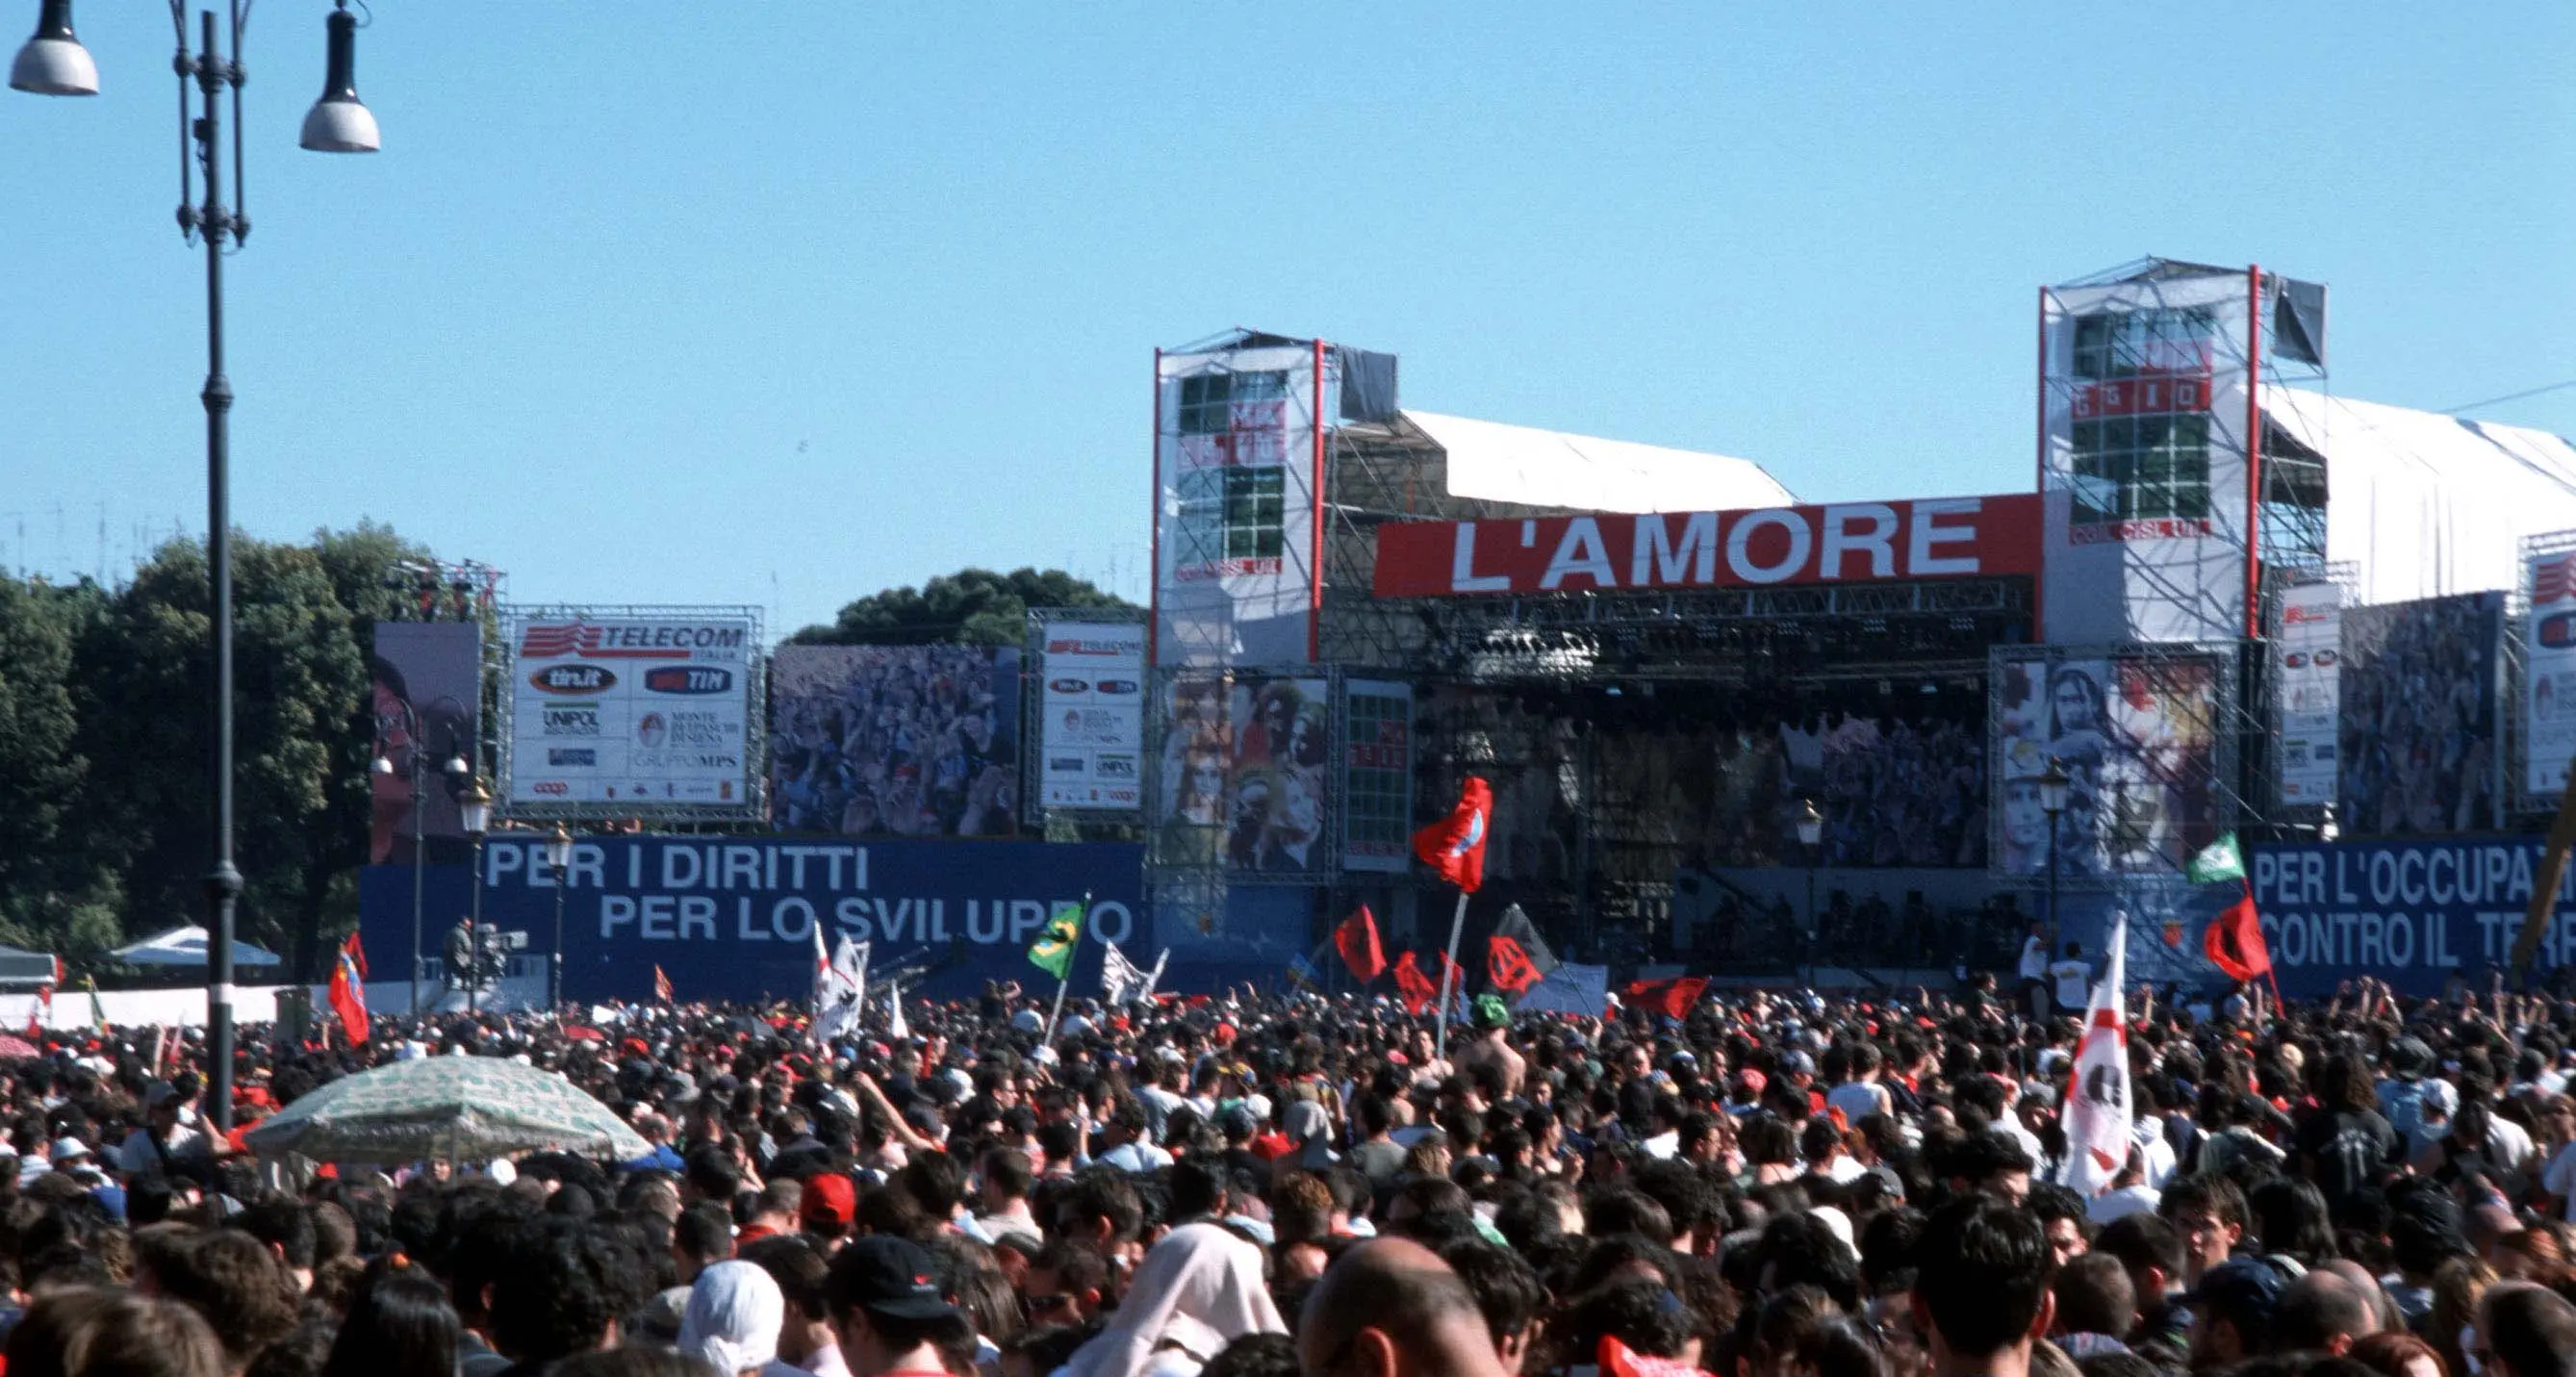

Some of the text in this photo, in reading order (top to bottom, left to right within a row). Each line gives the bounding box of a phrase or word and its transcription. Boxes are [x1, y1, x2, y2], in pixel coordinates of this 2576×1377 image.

[1451, 497, 1983, 592] L'AMORE
[605, 626, 743, 648] TELECOM
[543, 710, 599, 727] UNIPOL
[487, 844, 868, 890] PER I DIRITTI
[2254, 850, 2327, 905] PER
[599, 894, 1133, 945] PER LO SVILUPO
[2425, 910, 2461, 967] IL
